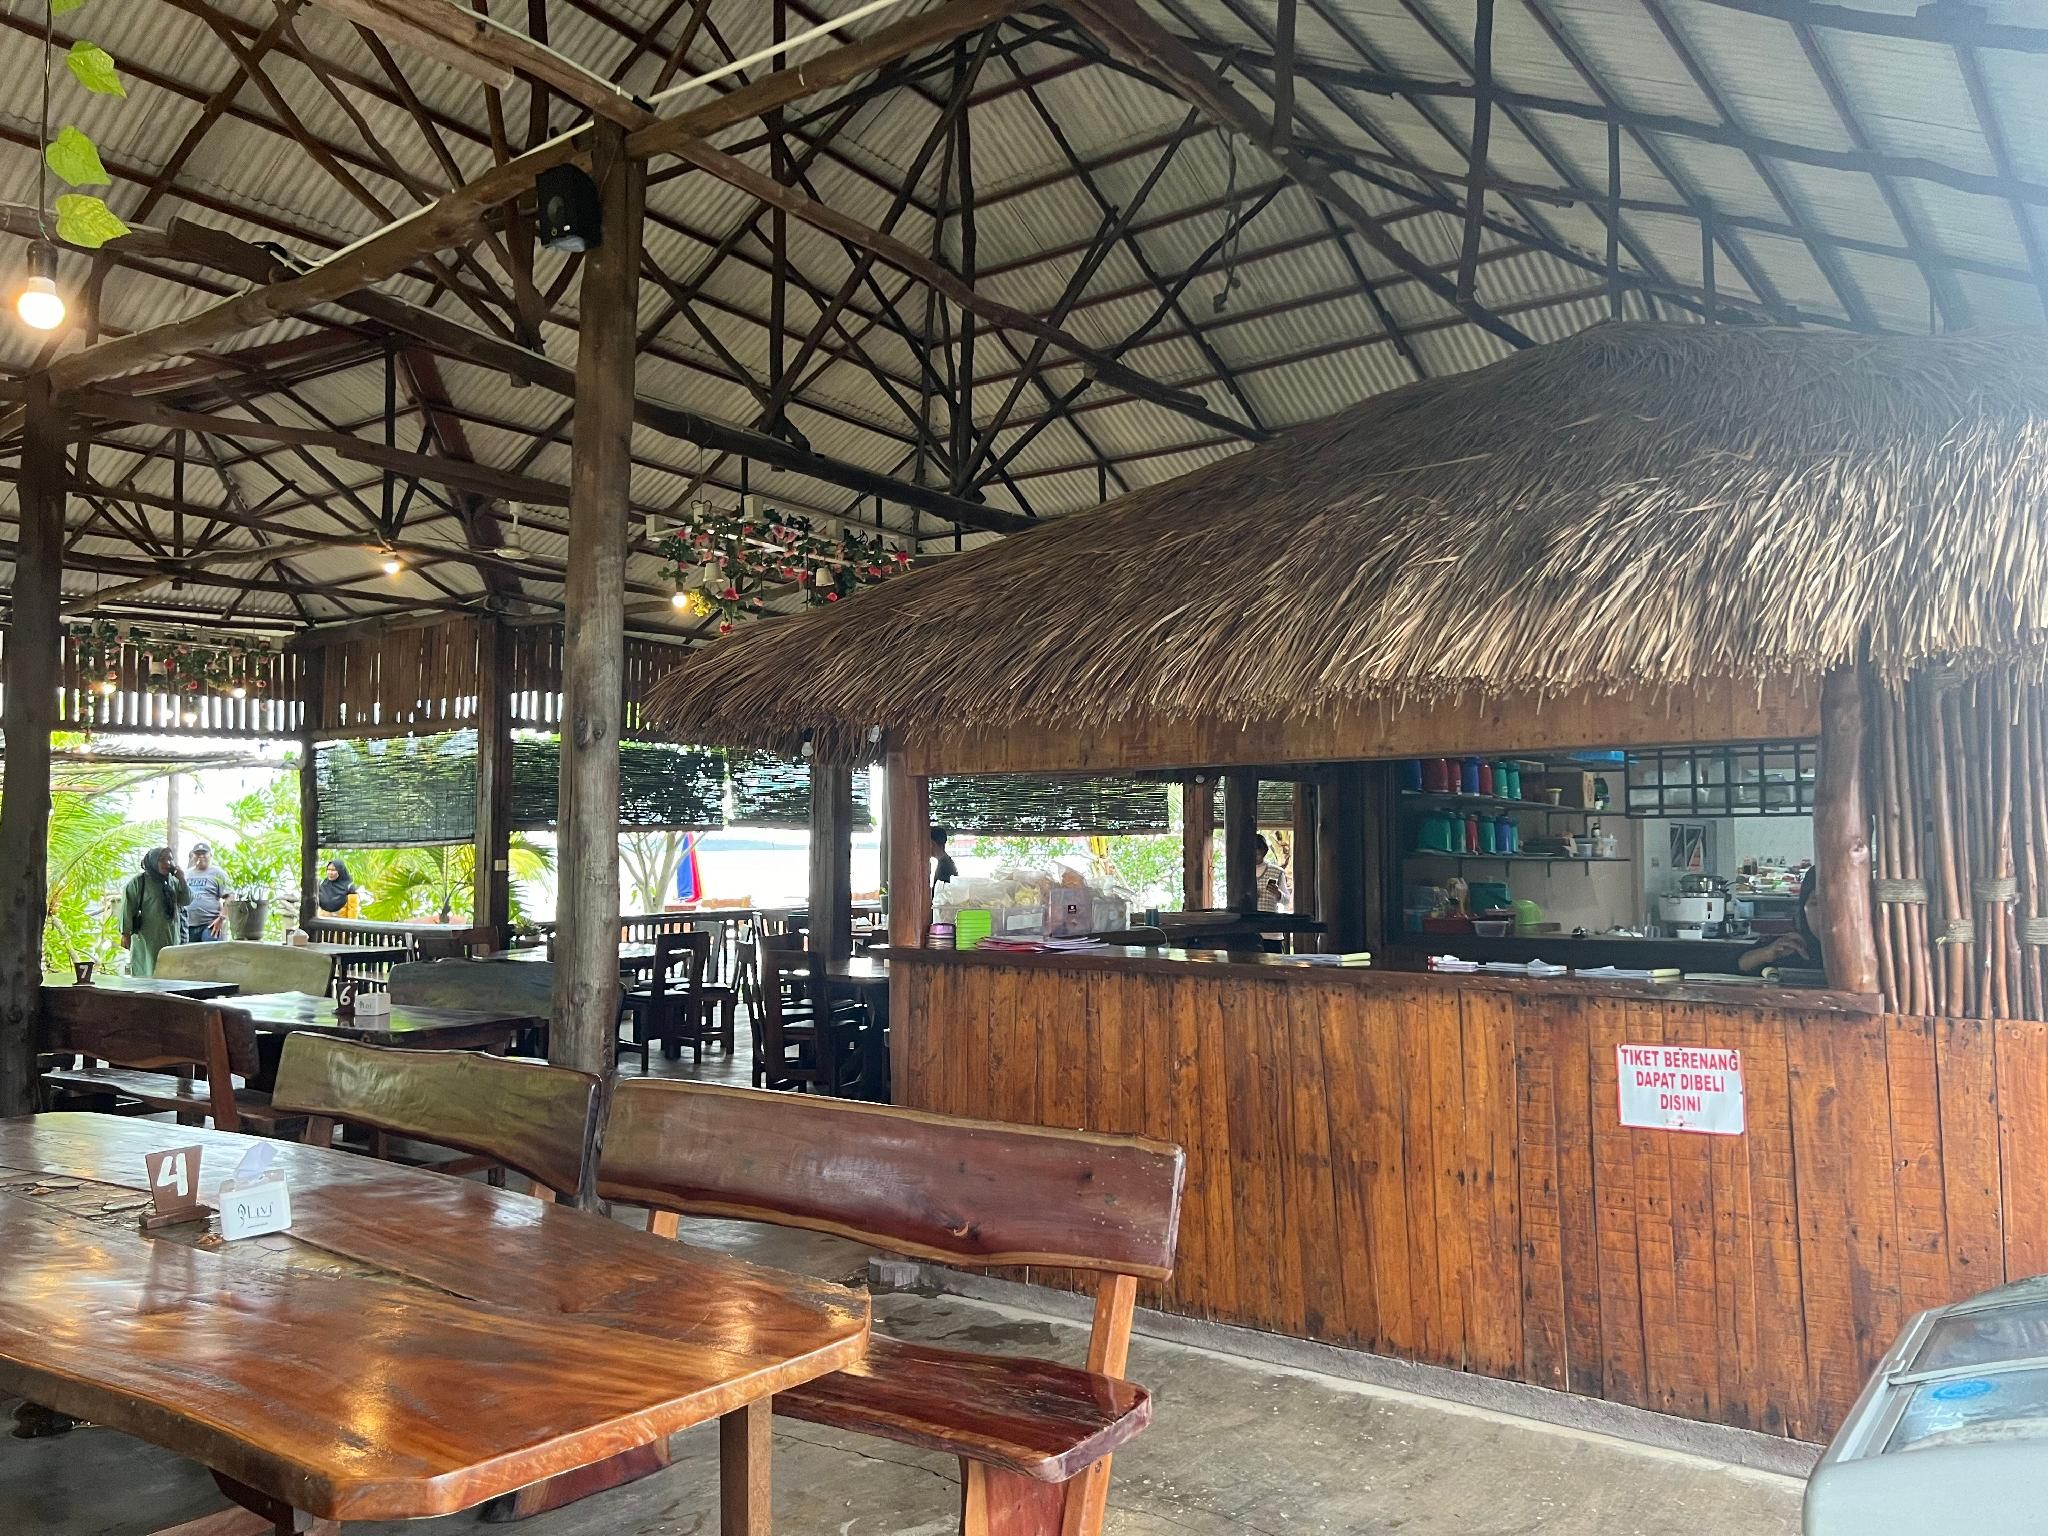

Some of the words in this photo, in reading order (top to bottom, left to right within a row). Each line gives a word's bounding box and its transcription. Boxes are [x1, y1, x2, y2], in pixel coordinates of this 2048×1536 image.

[79, 964, 89, 979] 7
[340, 985, 351, 1006] 6
[1621, 1049, 1659, 1067] TIKET
[1664, 1051, 1739, 1072] BERENANG
[1636, 1071, 1676, 1090] DAPAT
[1681, 1074, 1725, 1093] DIBELI
[1660, 1094, 1702, 1113] DISINI
[157, 1152, 189, 1197] 4
